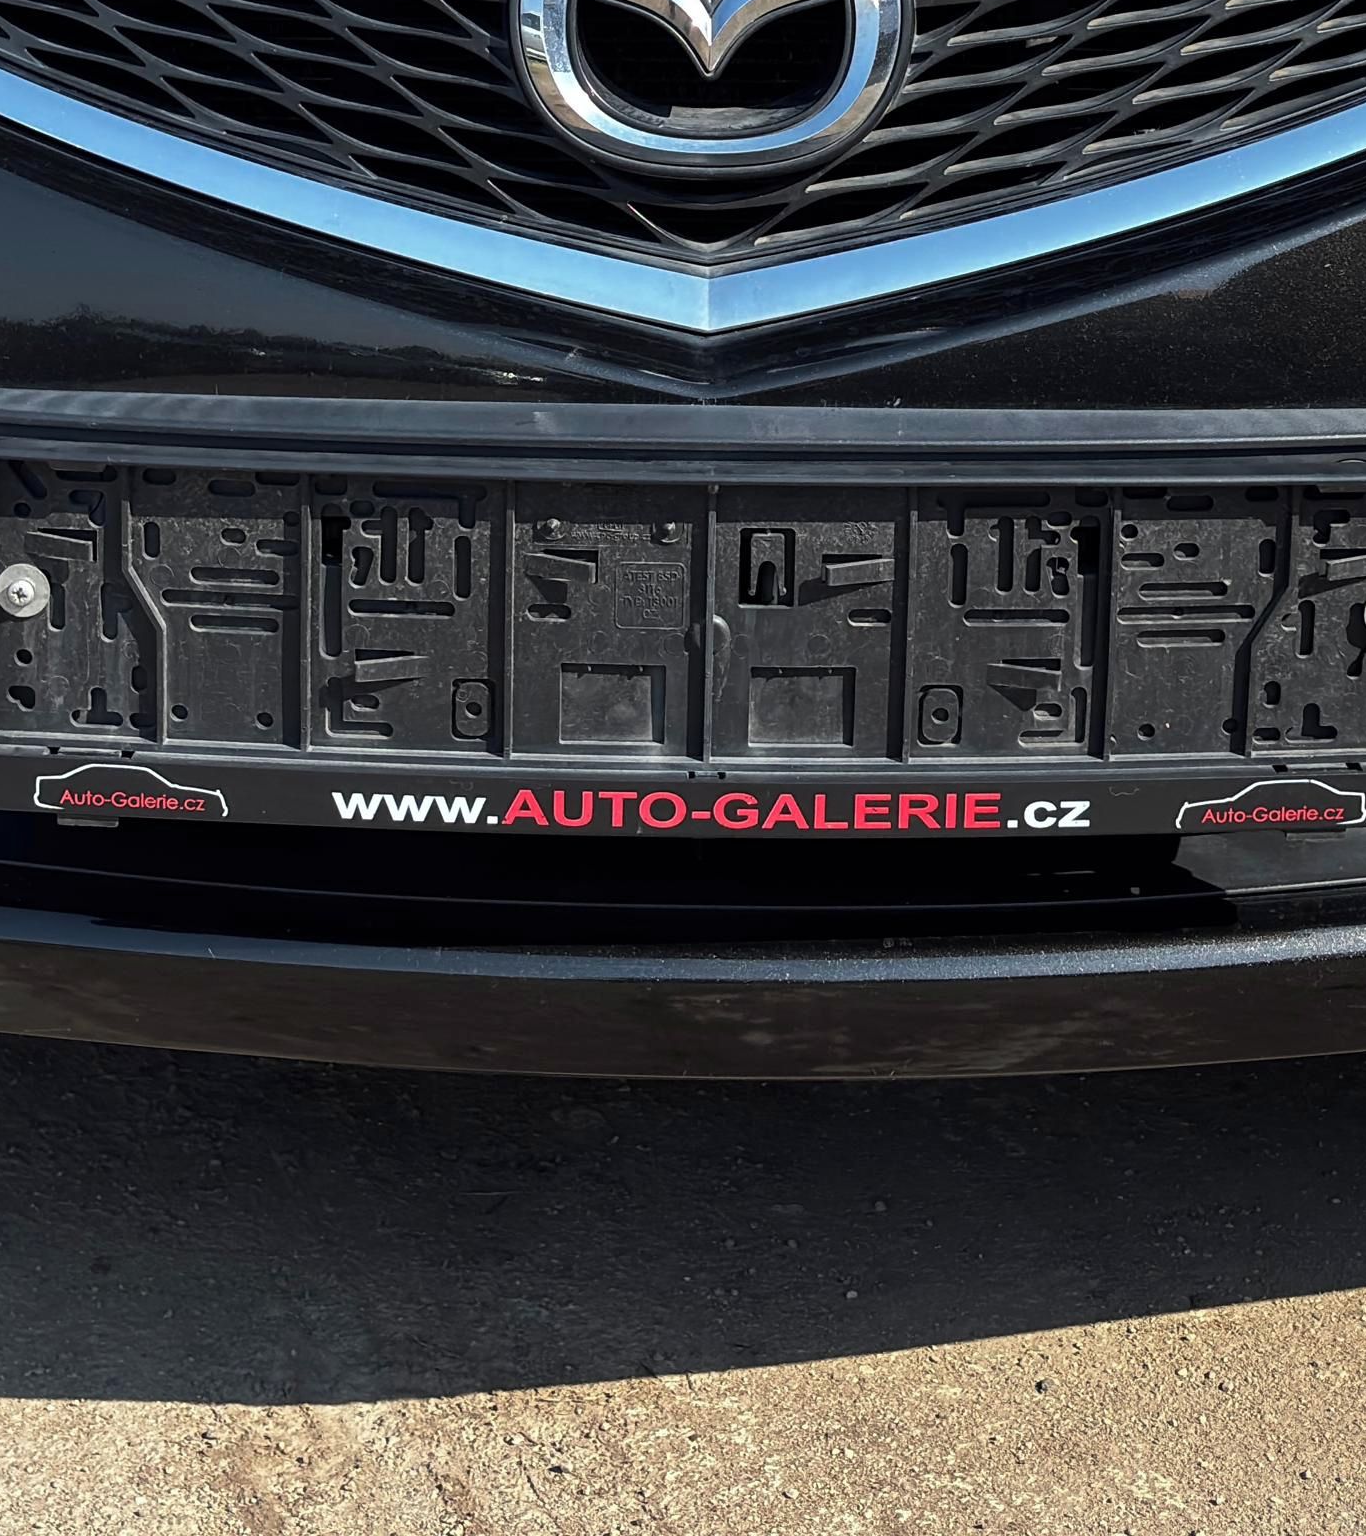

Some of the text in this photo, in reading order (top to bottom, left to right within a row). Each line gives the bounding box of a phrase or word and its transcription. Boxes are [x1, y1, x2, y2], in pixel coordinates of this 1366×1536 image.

[59, 789, 206, 812] Auto-Galerie.cz
[331, 788, 1091, 829] www.AUTO-GALERIE.cz
[1200, 805, 1345, 825] Auto-Galerie.cz
